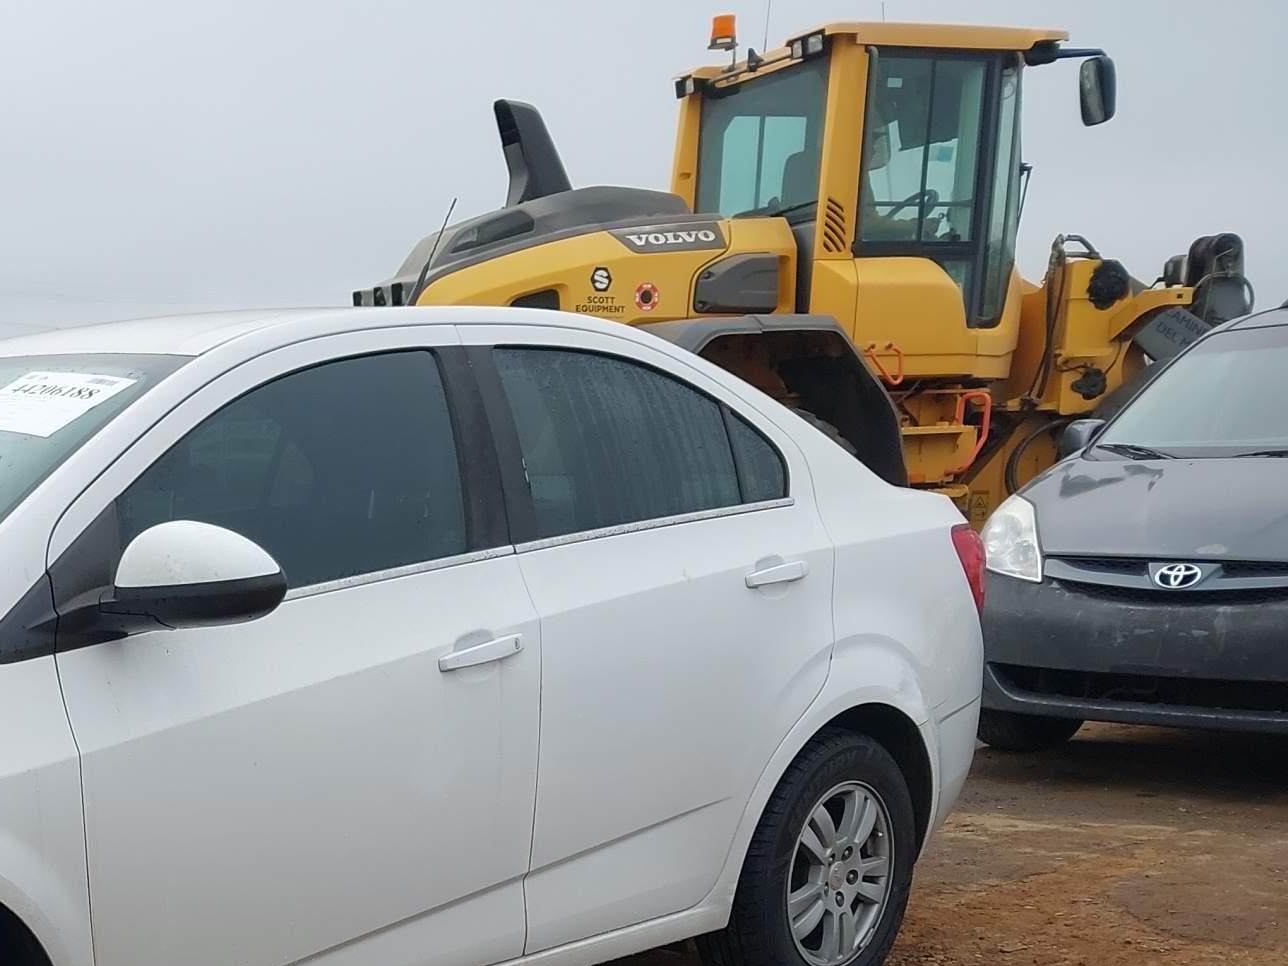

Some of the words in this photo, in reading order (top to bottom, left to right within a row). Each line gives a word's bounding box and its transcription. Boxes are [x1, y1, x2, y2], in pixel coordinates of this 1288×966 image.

[625, 230, 716, 246] VOLVO
[586, 296, 616, 304] SCOTT
[575, 304, 626, 313] EQUIPMENT
[11, 383, 101, 400] 44206188
